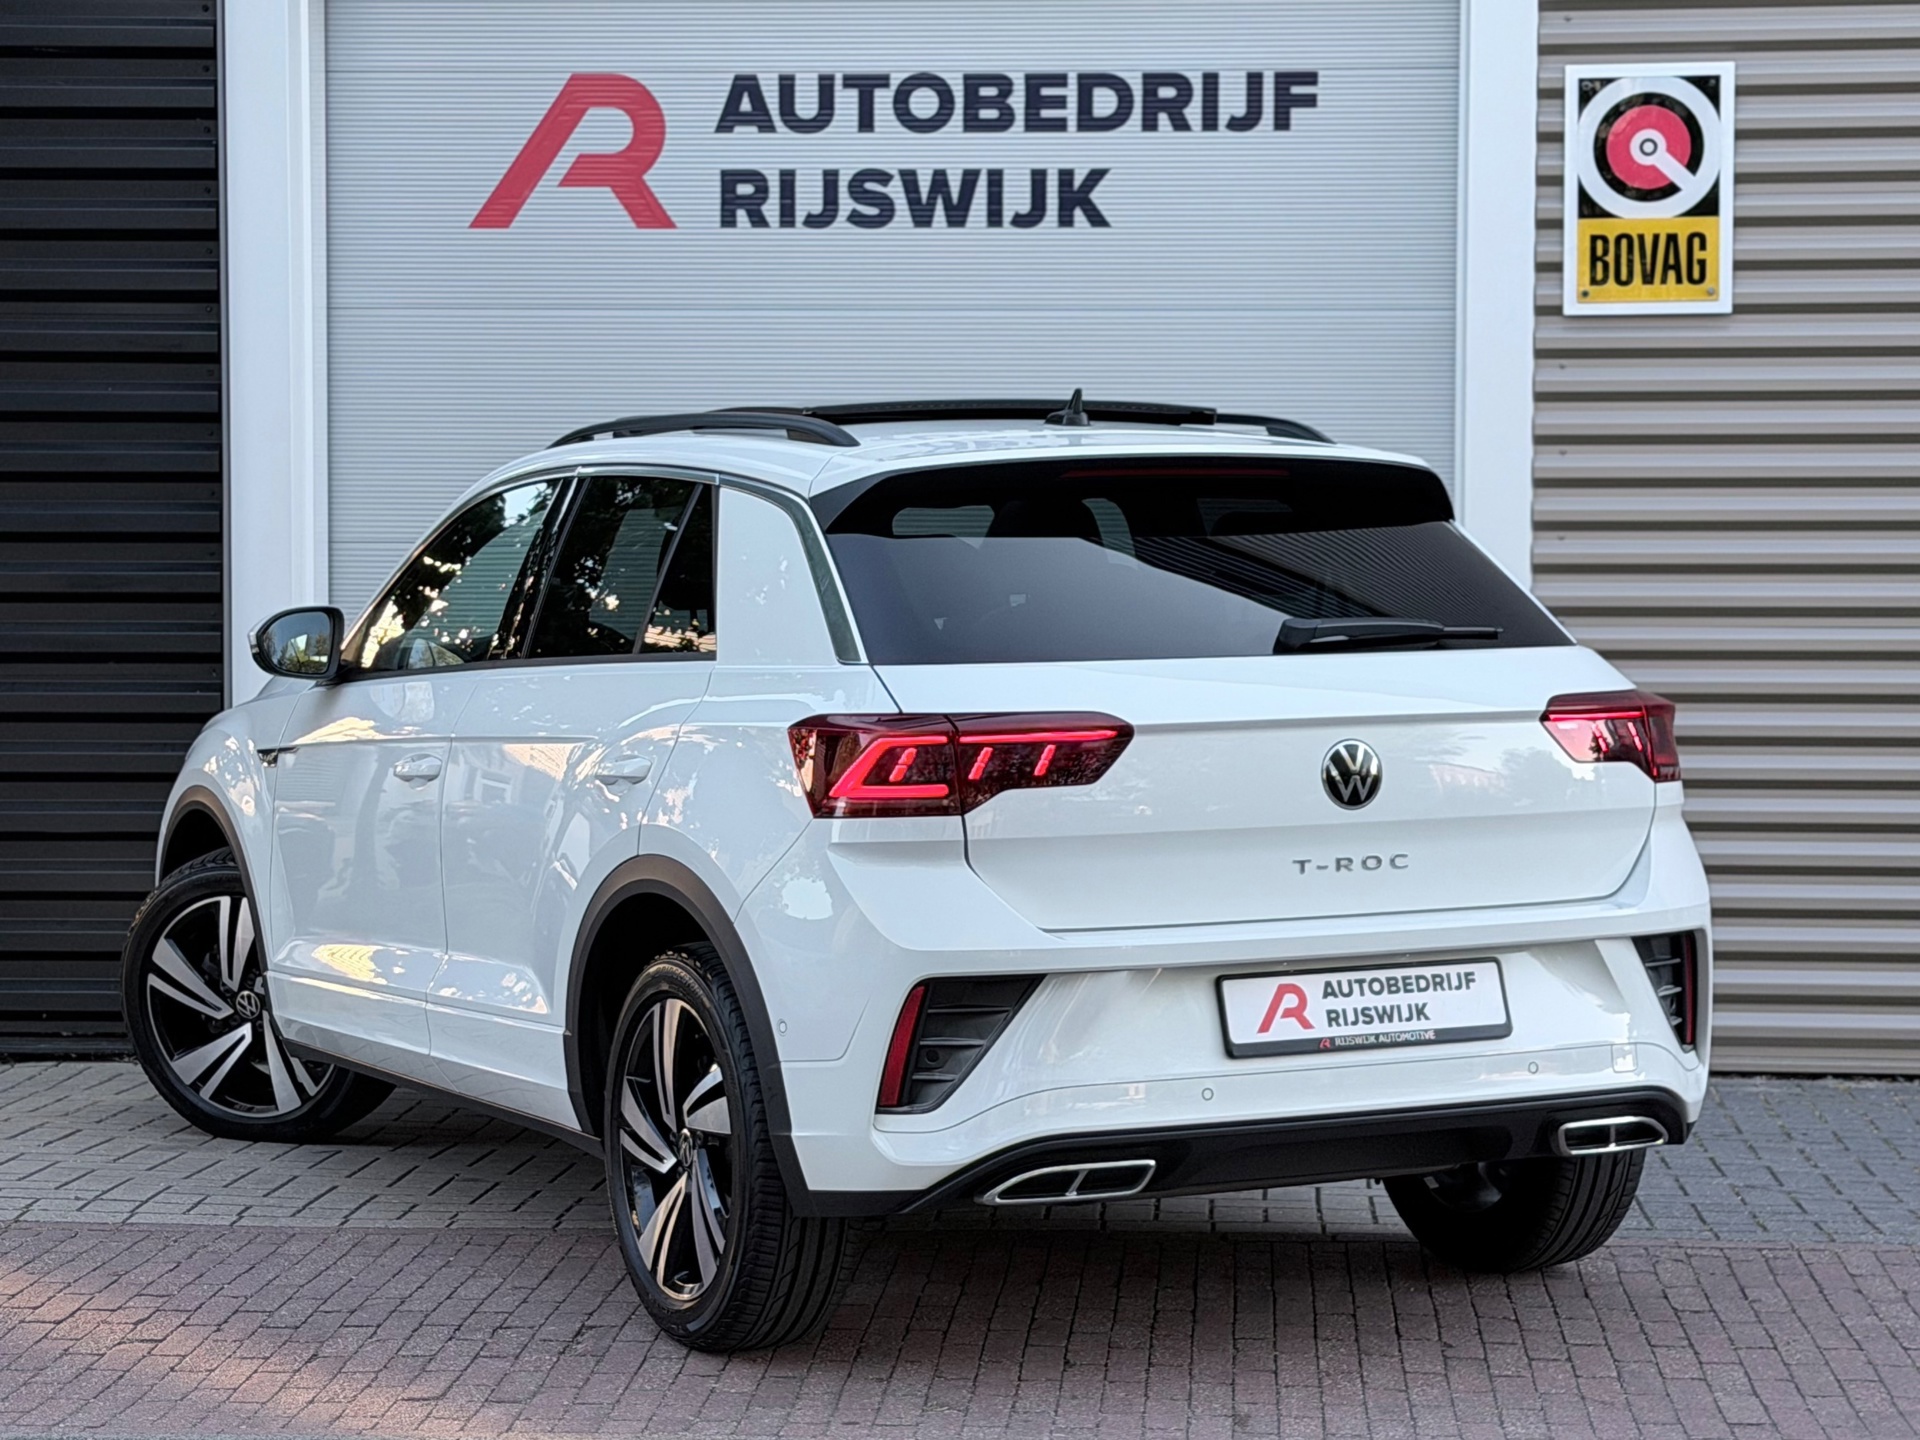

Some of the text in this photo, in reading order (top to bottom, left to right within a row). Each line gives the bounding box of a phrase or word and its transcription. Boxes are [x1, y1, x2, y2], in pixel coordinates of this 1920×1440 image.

[714, 70, 1319, 134] AUTOBEDRIJF
[719, 168, 1112, 229] RIJSWIJK
[1589, 232, 1707, 286] BOVAG
[1292, 853, 1410, 876] T-ROC
[1322, 972, 1476, 999] AUTOBEDRIJF
[1325, 1002, 1430, 1028] RIJSWIJK
[1334, 1029, 1436, 1046] RIJSWIJK AUTOMOTIVE
